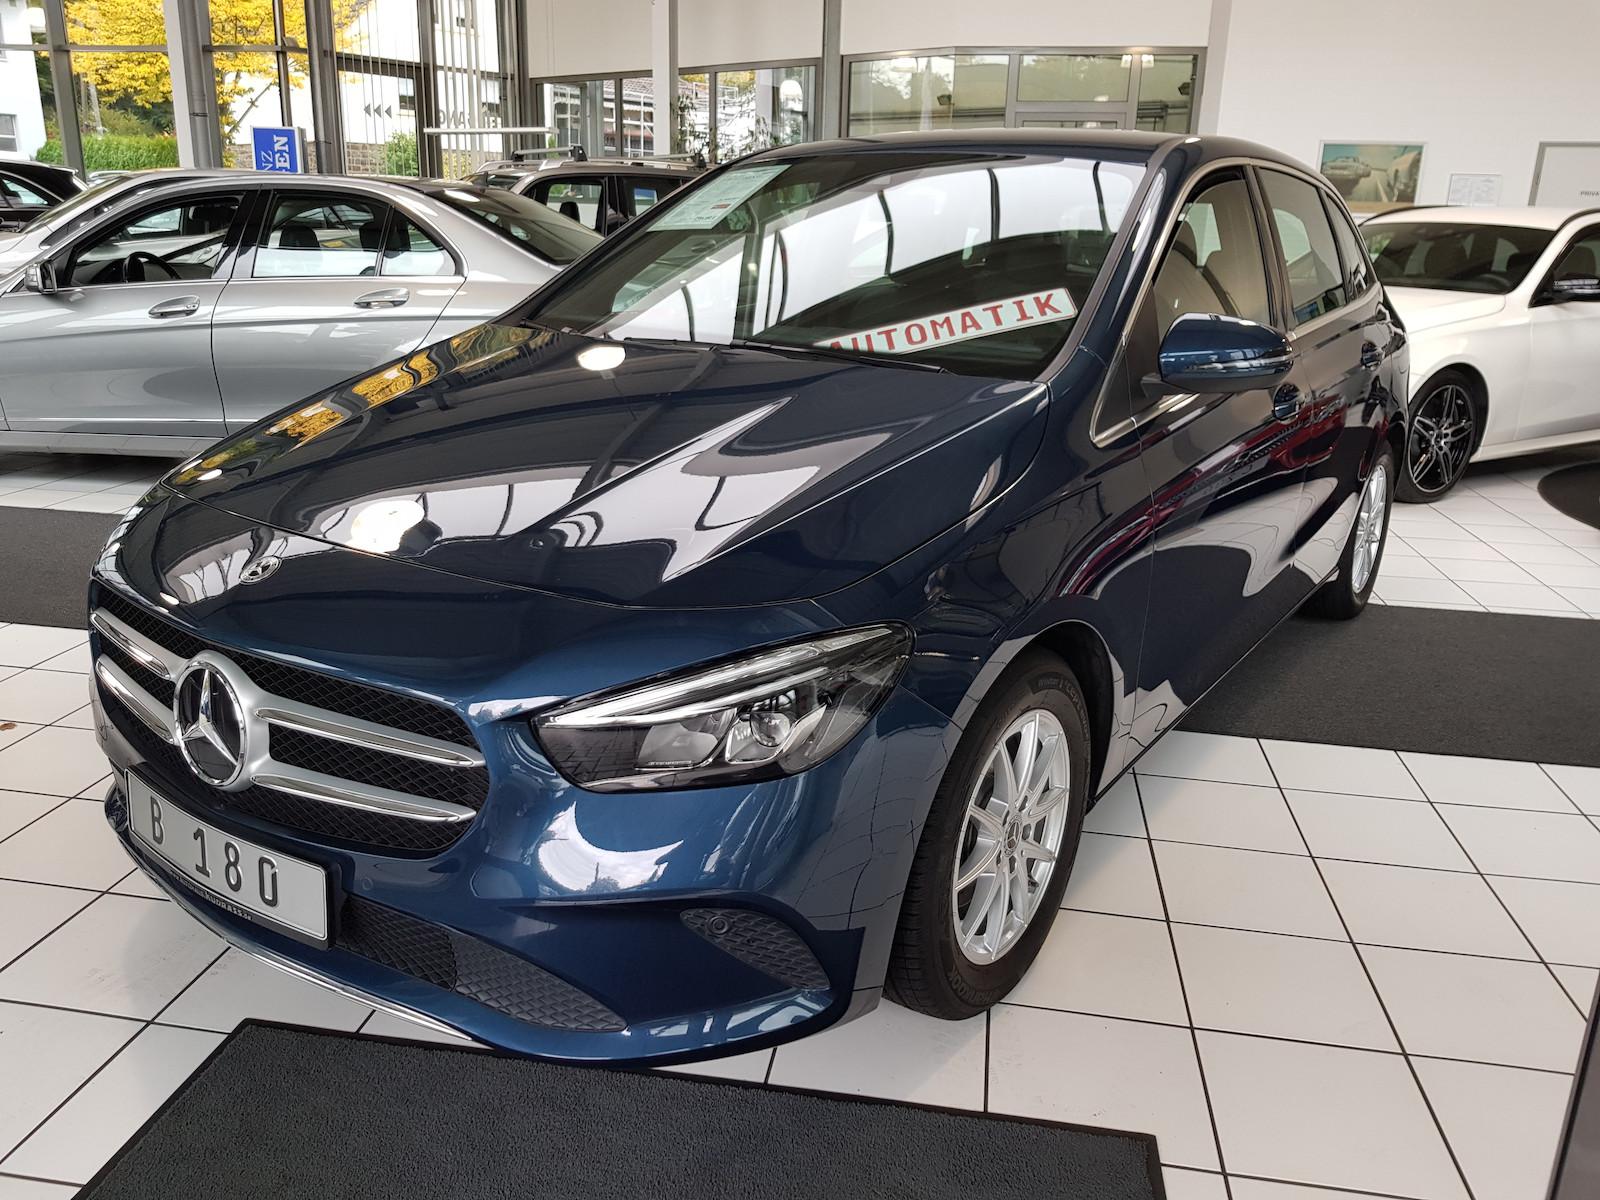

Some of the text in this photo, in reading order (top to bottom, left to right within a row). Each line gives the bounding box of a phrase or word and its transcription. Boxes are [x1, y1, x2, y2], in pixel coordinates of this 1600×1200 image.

[273, 134, 291, 172] EN
[152, 797, 164, 845] B
[193, 827, 278, 907] 180
